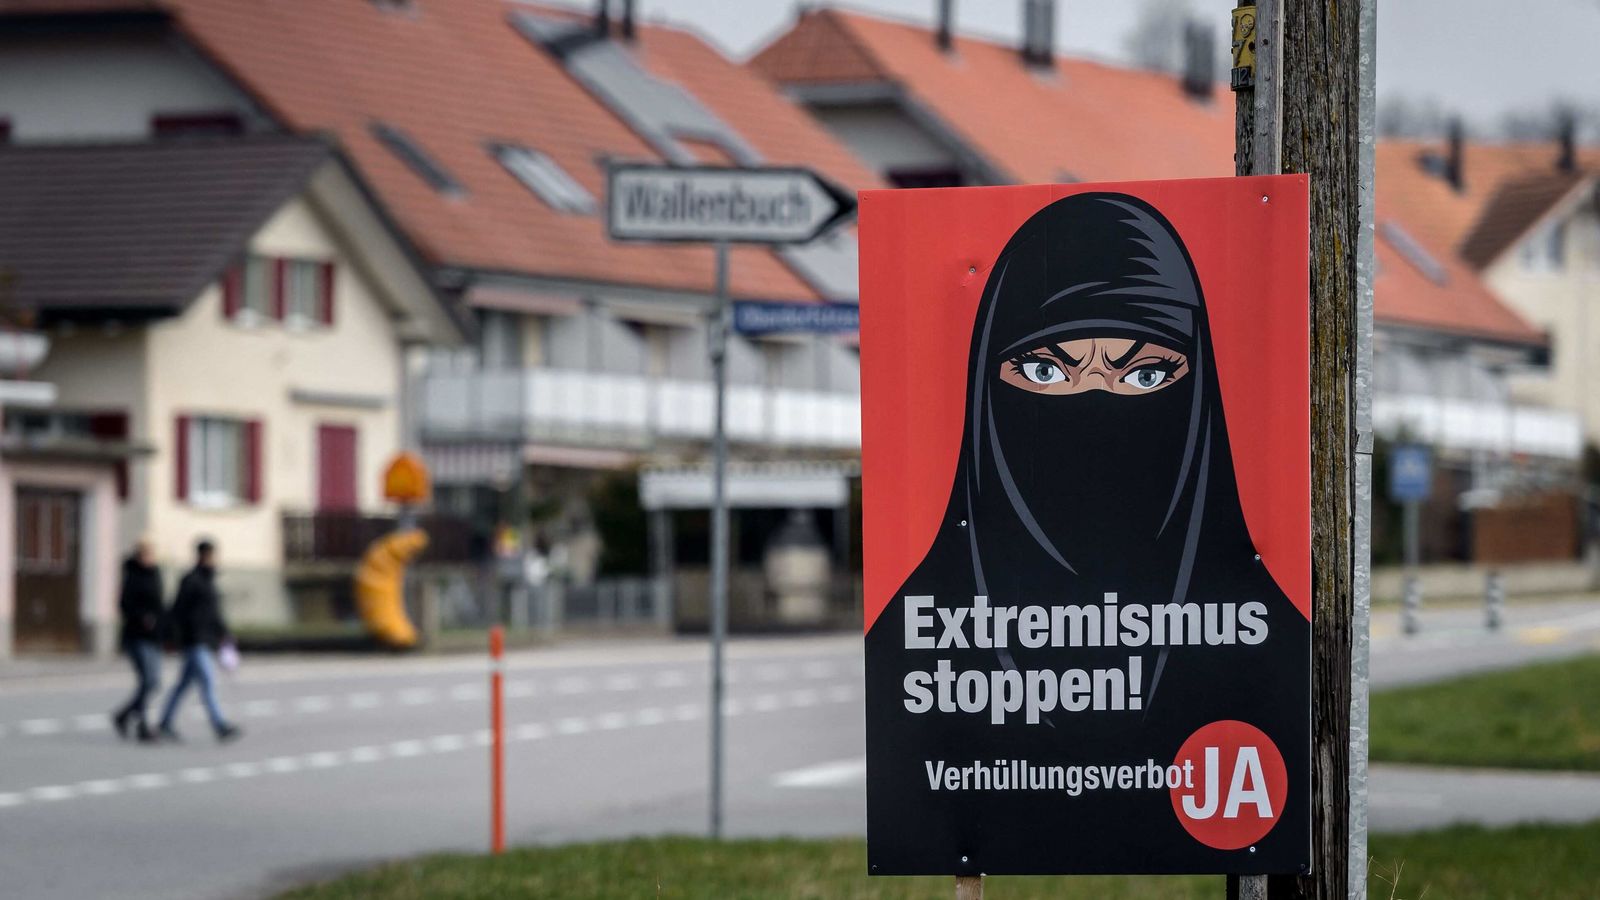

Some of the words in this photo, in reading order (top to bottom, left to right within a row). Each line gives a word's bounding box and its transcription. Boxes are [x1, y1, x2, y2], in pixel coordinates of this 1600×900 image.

[624, 181, 811, 222] Wallenbuch
[904, 592, 1269, 649] Extremismus
[903, 656, 1142, 724] stoppen!
[925, 759, 1194, 796] Verhüllungsverbot
[1181, 746, 1274, 820] JA
